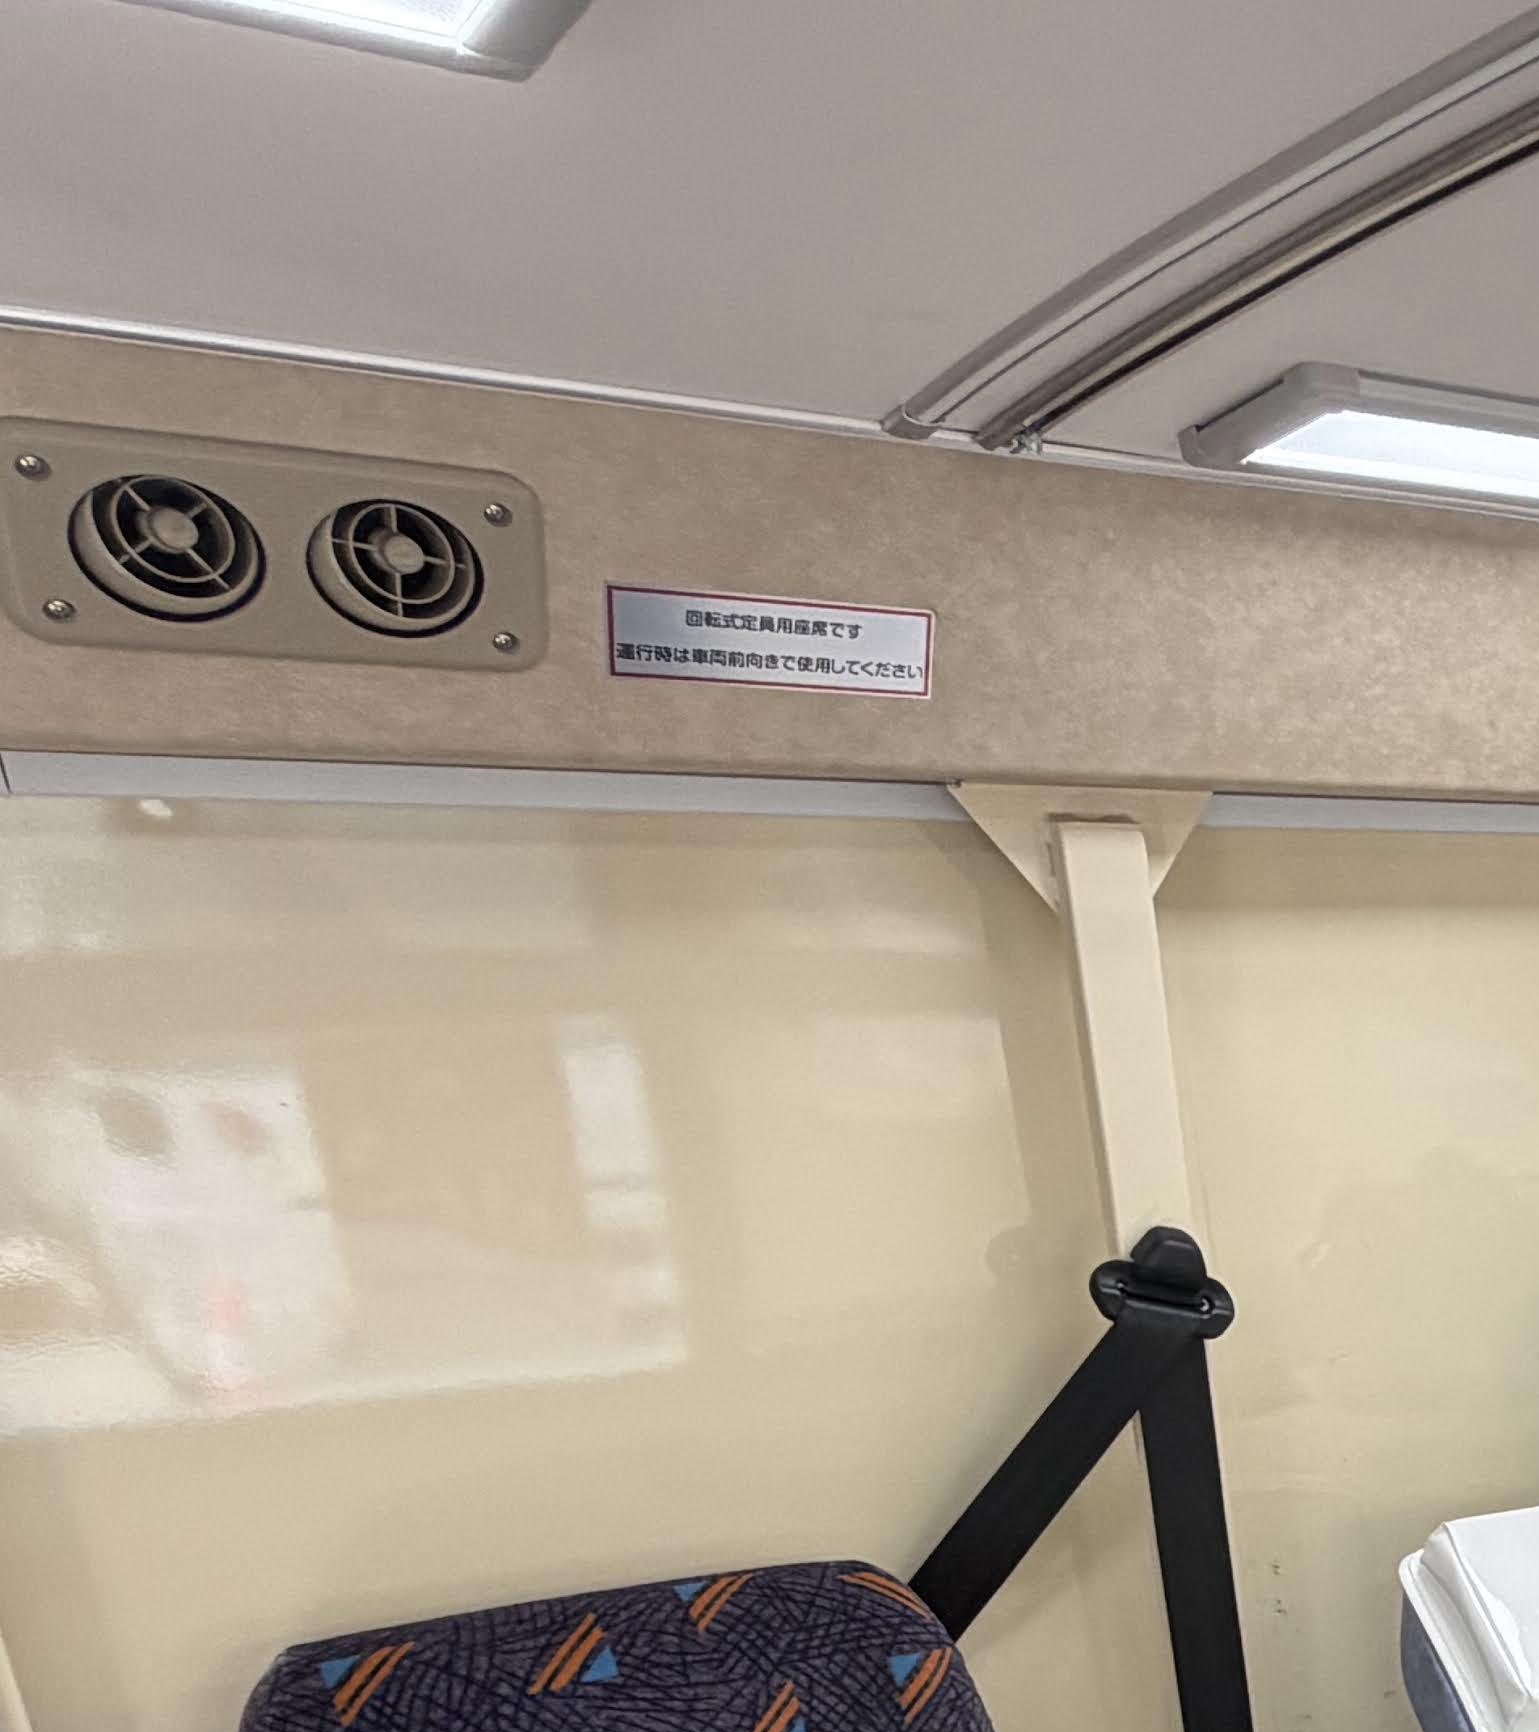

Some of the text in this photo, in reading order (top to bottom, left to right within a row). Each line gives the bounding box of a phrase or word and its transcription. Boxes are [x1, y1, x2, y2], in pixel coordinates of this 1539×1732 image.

[685, 609, 863, 639] 回転式定員用座席です
[616, 642, 924, 679] 運行時は車両前向きで使用してください
